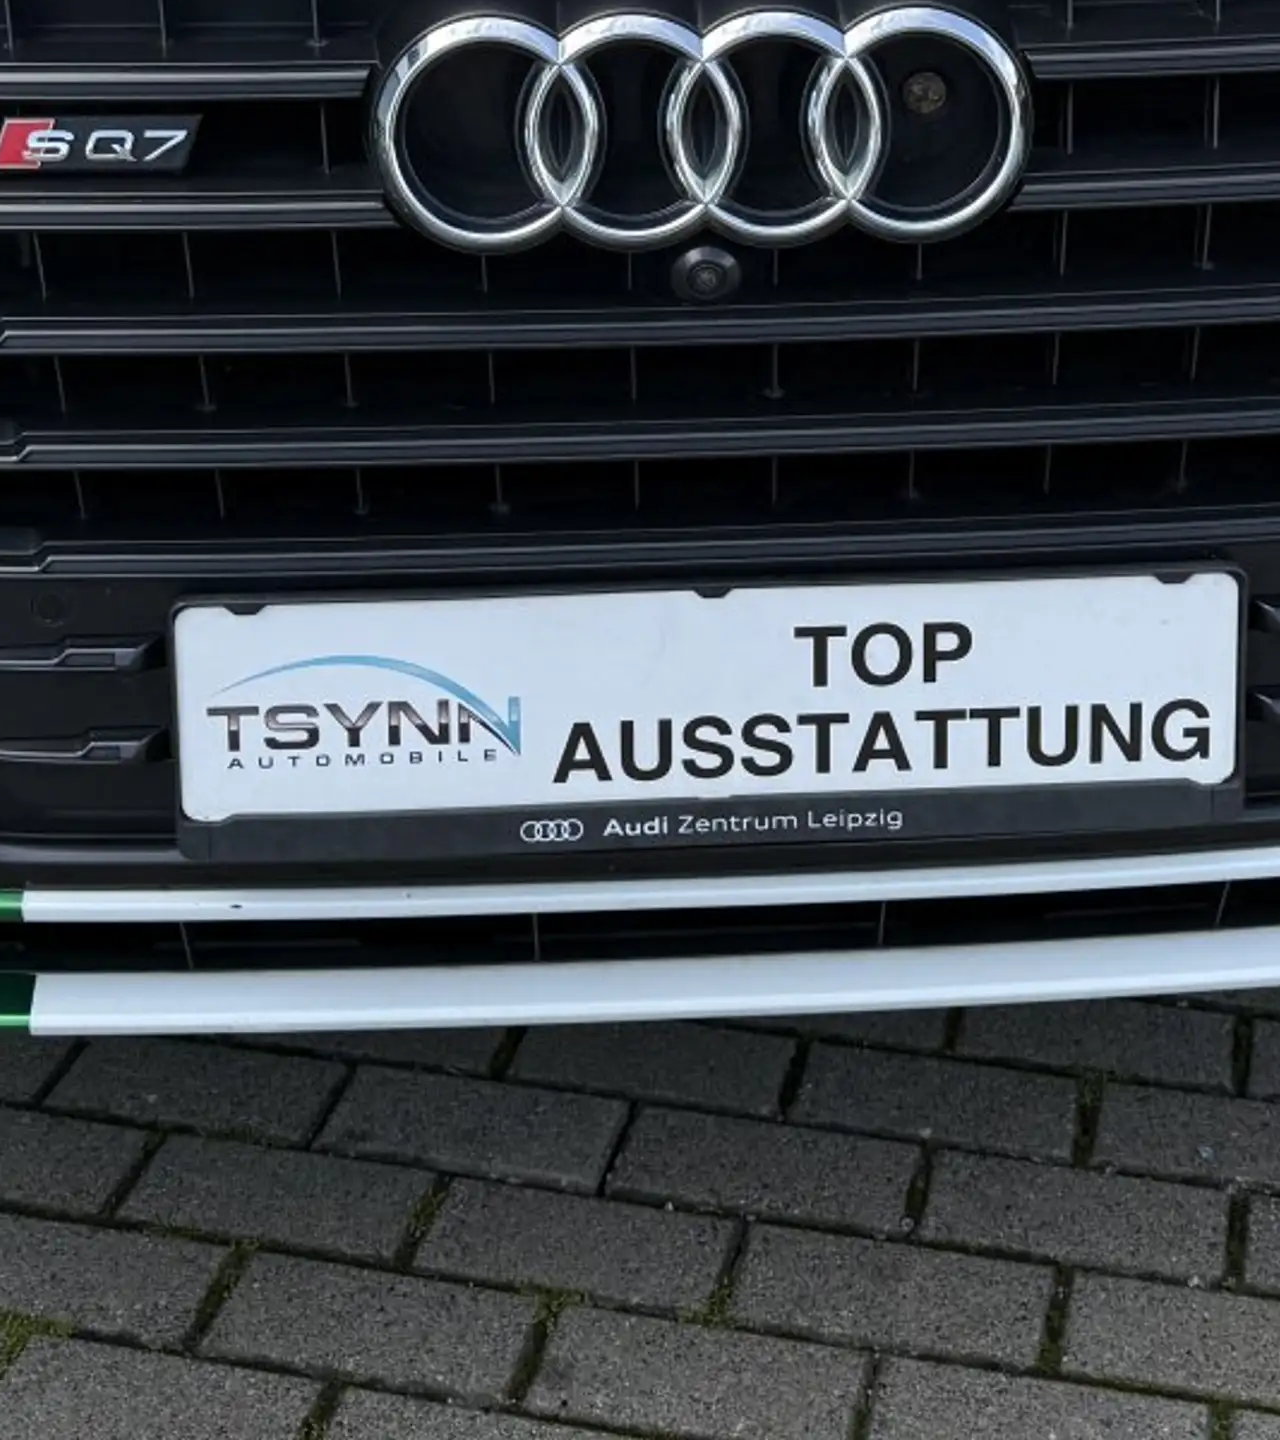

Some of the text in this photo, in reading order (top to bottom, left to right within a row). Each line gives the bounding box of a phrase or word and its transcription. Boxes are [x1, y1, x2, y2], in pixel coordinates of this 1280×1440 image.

[794, 621, 972, 687] TOP
[206, 697, 520, 757] TSYNN
[553, 698, 1211, 783] AUSSTATTUNG
[227, 748, 497, 770] AUTOMOBILE
[603, 807, 904, 837] Audi Zentrum Leipzig
